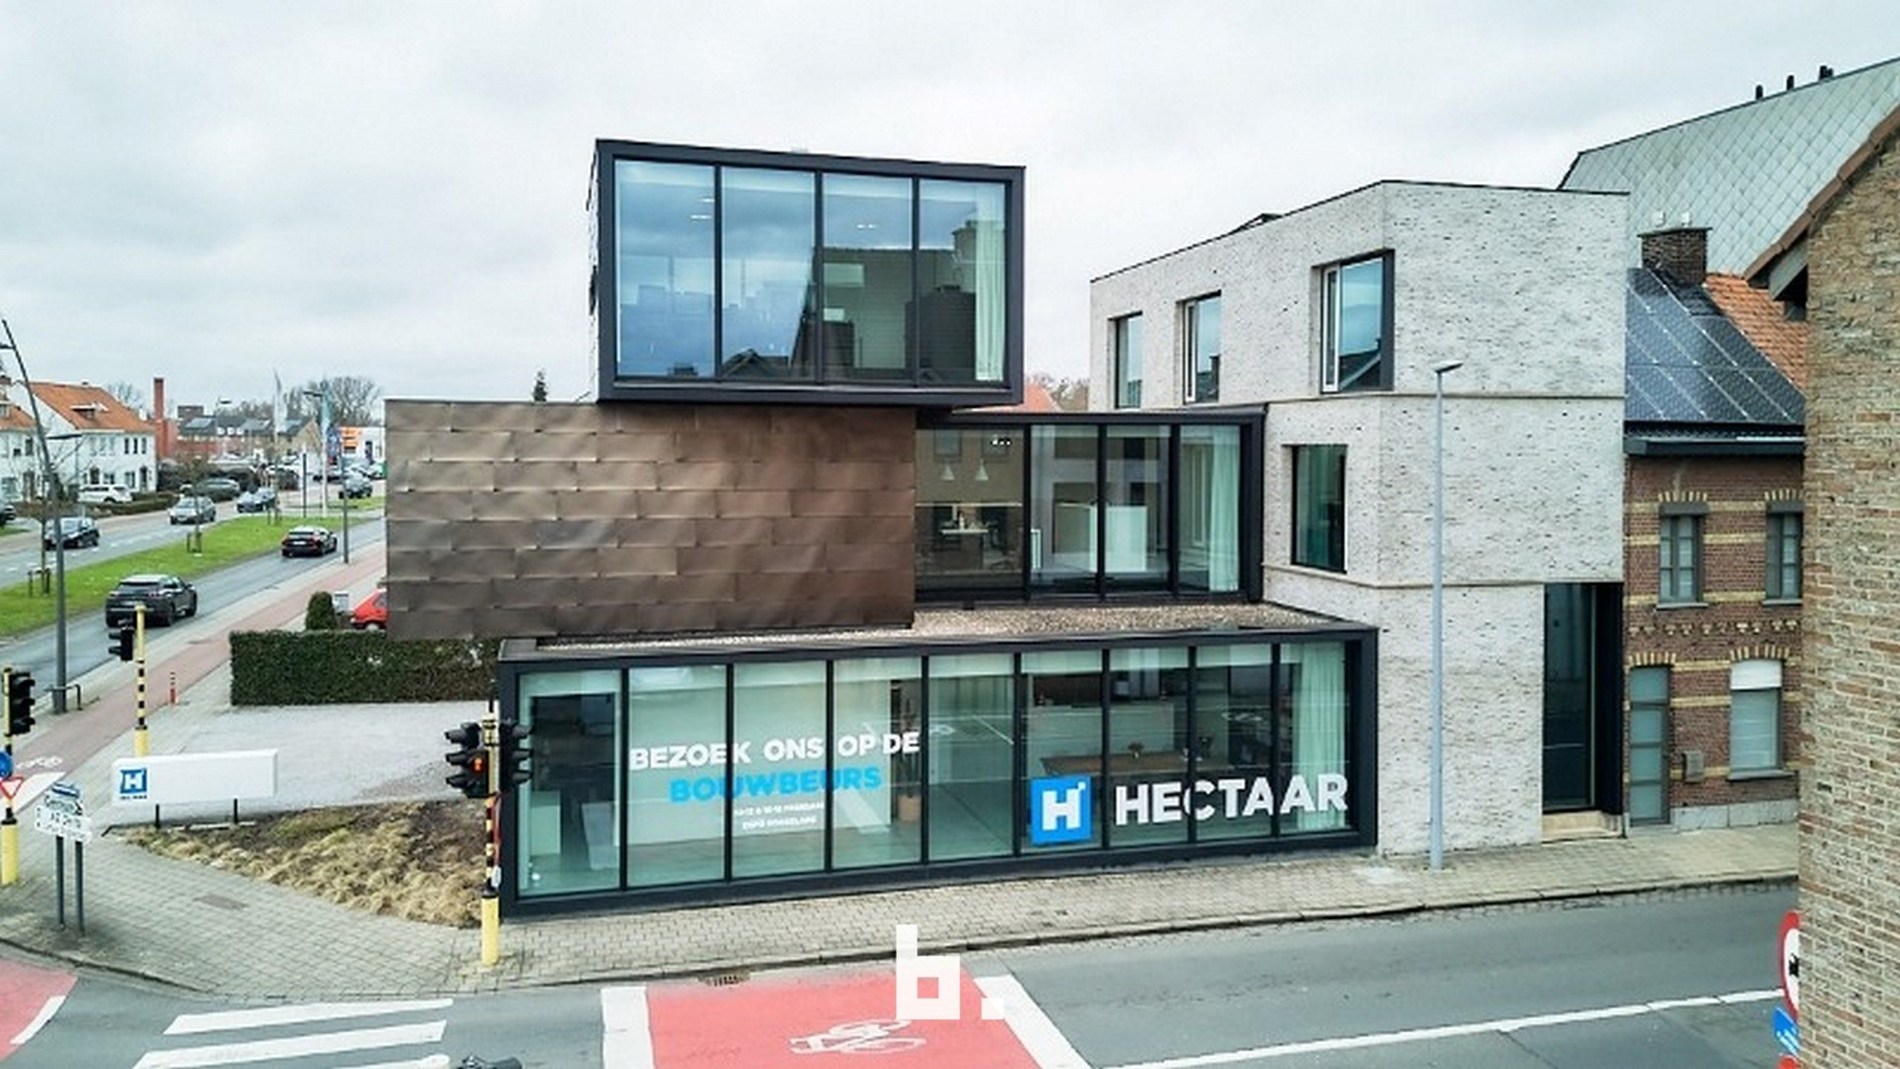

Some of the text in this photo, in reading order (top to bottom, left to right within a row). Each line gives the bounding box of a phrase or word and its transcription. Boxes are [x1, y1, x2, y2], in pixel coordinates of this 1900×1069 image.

[629, 731, 921, 771] BEZOEK ONS OP DE
[669, 766, 881, 804] BOUWBEURS
[1042, 773, 1348, 832] H HECTAAR
